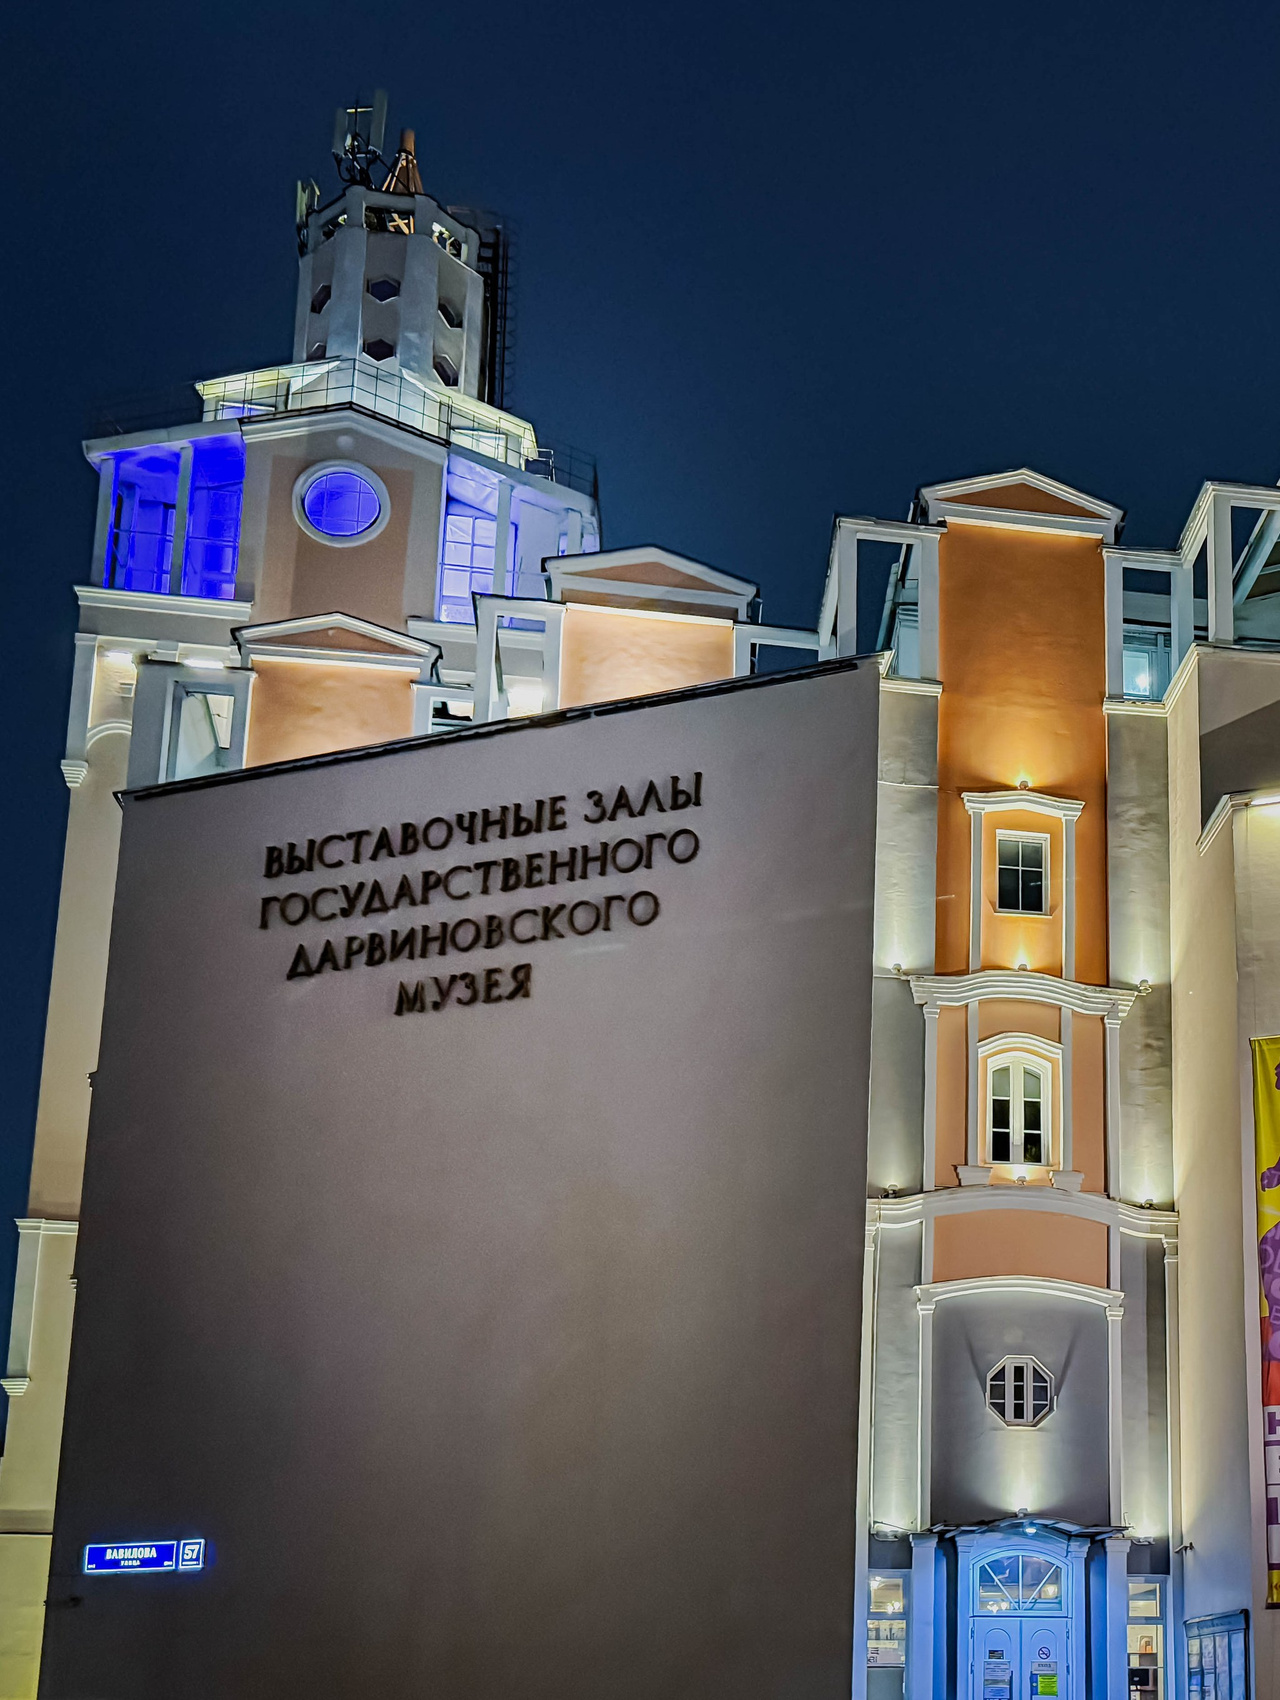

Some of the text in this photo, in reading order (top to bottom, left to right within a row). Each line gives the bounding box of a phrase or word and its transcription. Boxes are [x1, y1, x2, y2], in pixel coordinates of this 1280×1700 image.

[263, 771, 703, 879] ВЫСТАВОЧНЫЕ ЗАЛЫ
[259, 828, 700, 930] ГОСУДАРСТВЕННОГО
[286, 891, 660, 980] ДАРВИНОВСКОГО
[394, 963, 532, 1016] МУЗЕЯ
[105, 1547, 157, 1560] ВАВИЛОВА
[184, 1545, 200, 1560] 57
